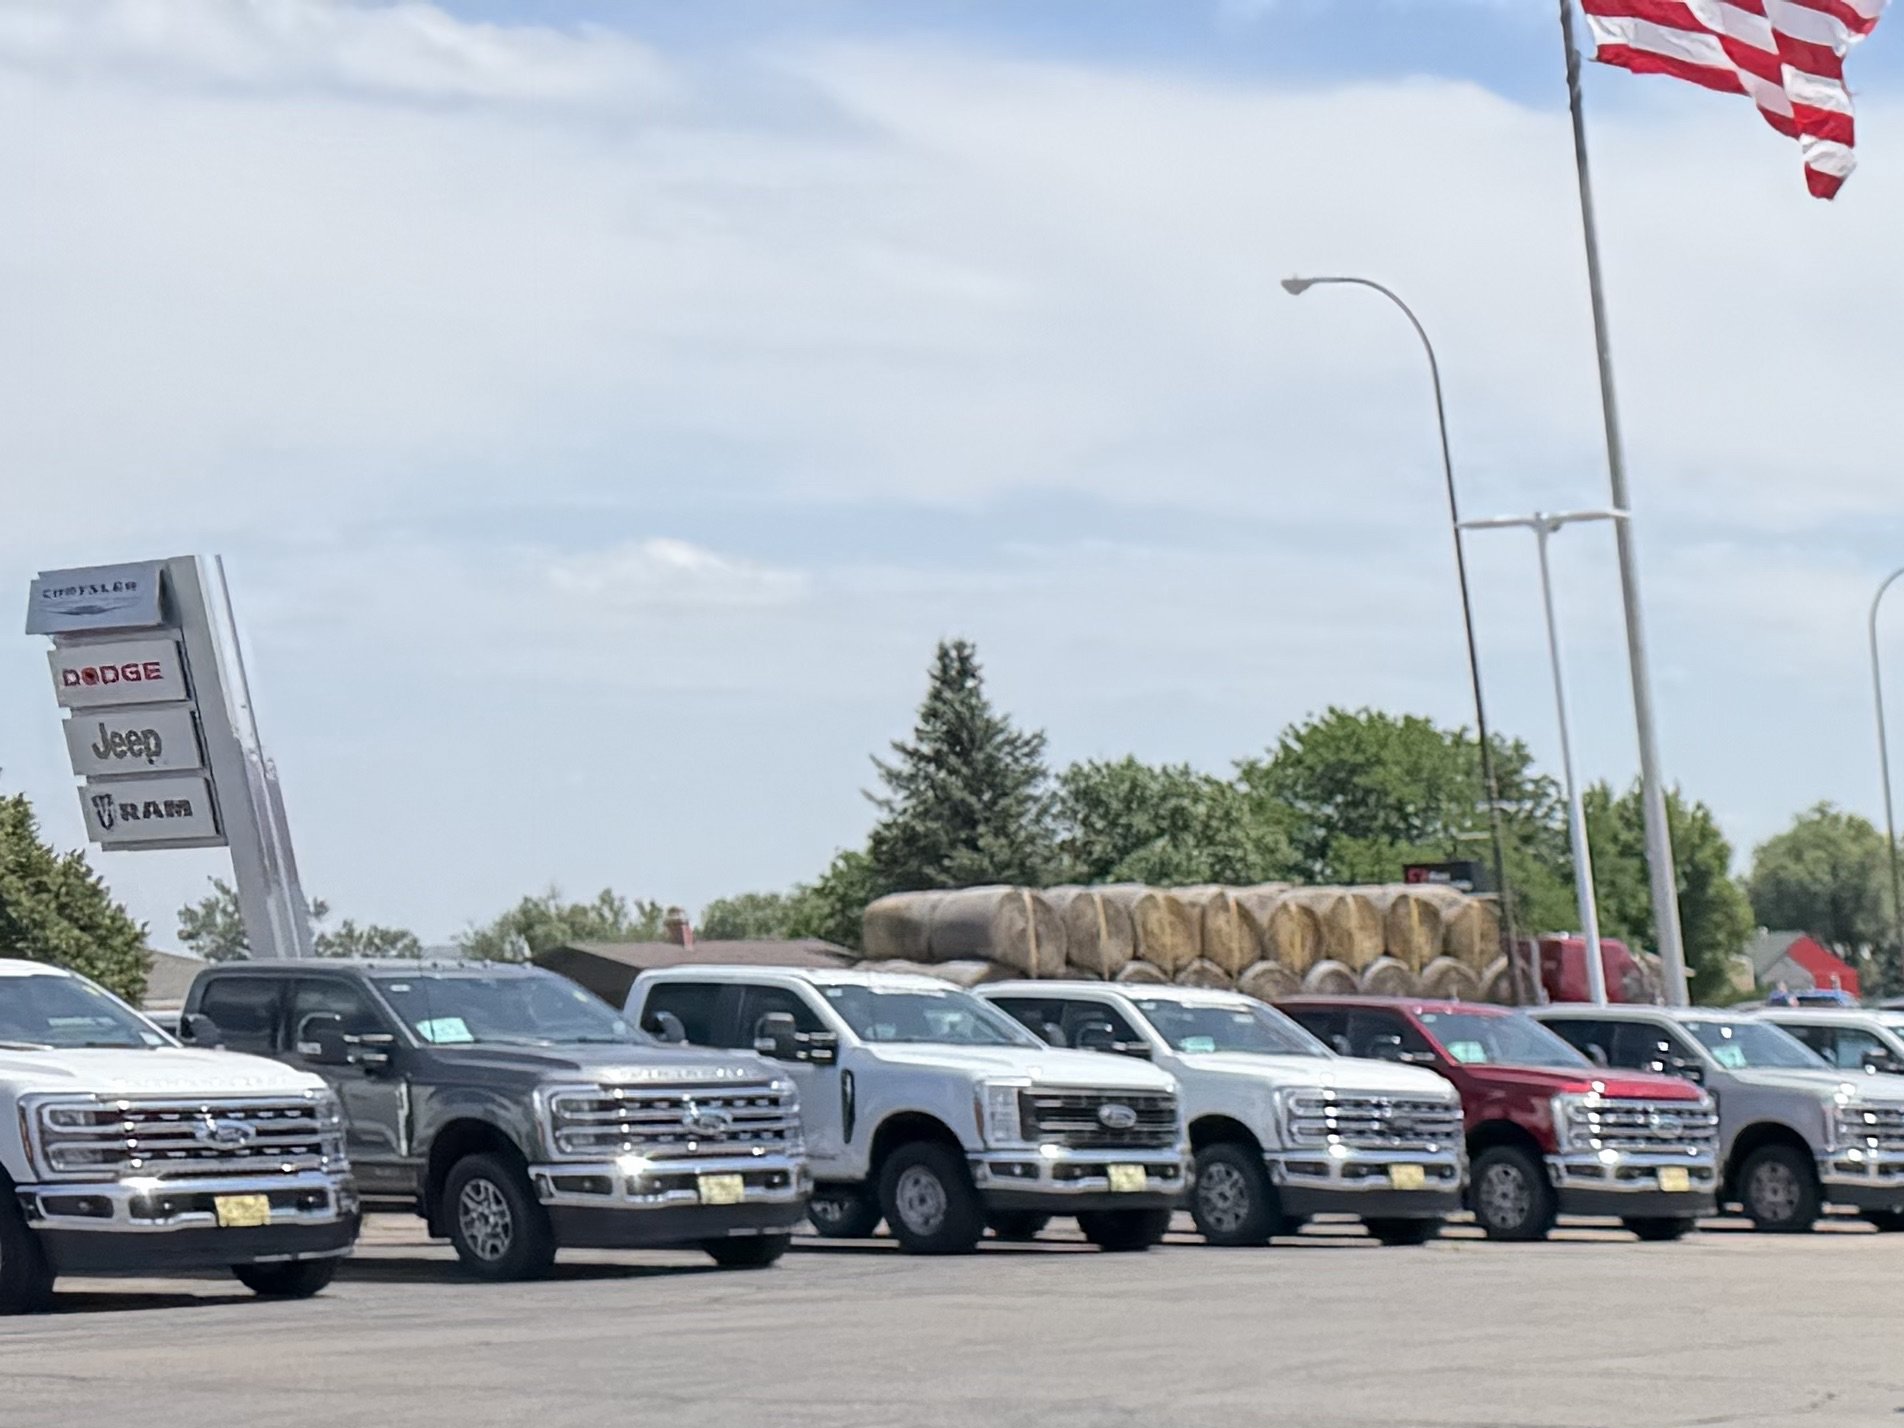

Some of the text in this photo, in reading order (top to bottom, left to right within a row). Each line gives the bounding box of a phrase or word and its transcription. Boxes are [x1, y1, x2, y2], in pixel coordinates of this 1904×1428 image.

[62, 661, 164, 687] DODGE
[91, 722, 163, 766] Jeep
[119, 798, 193, 822] RAM
